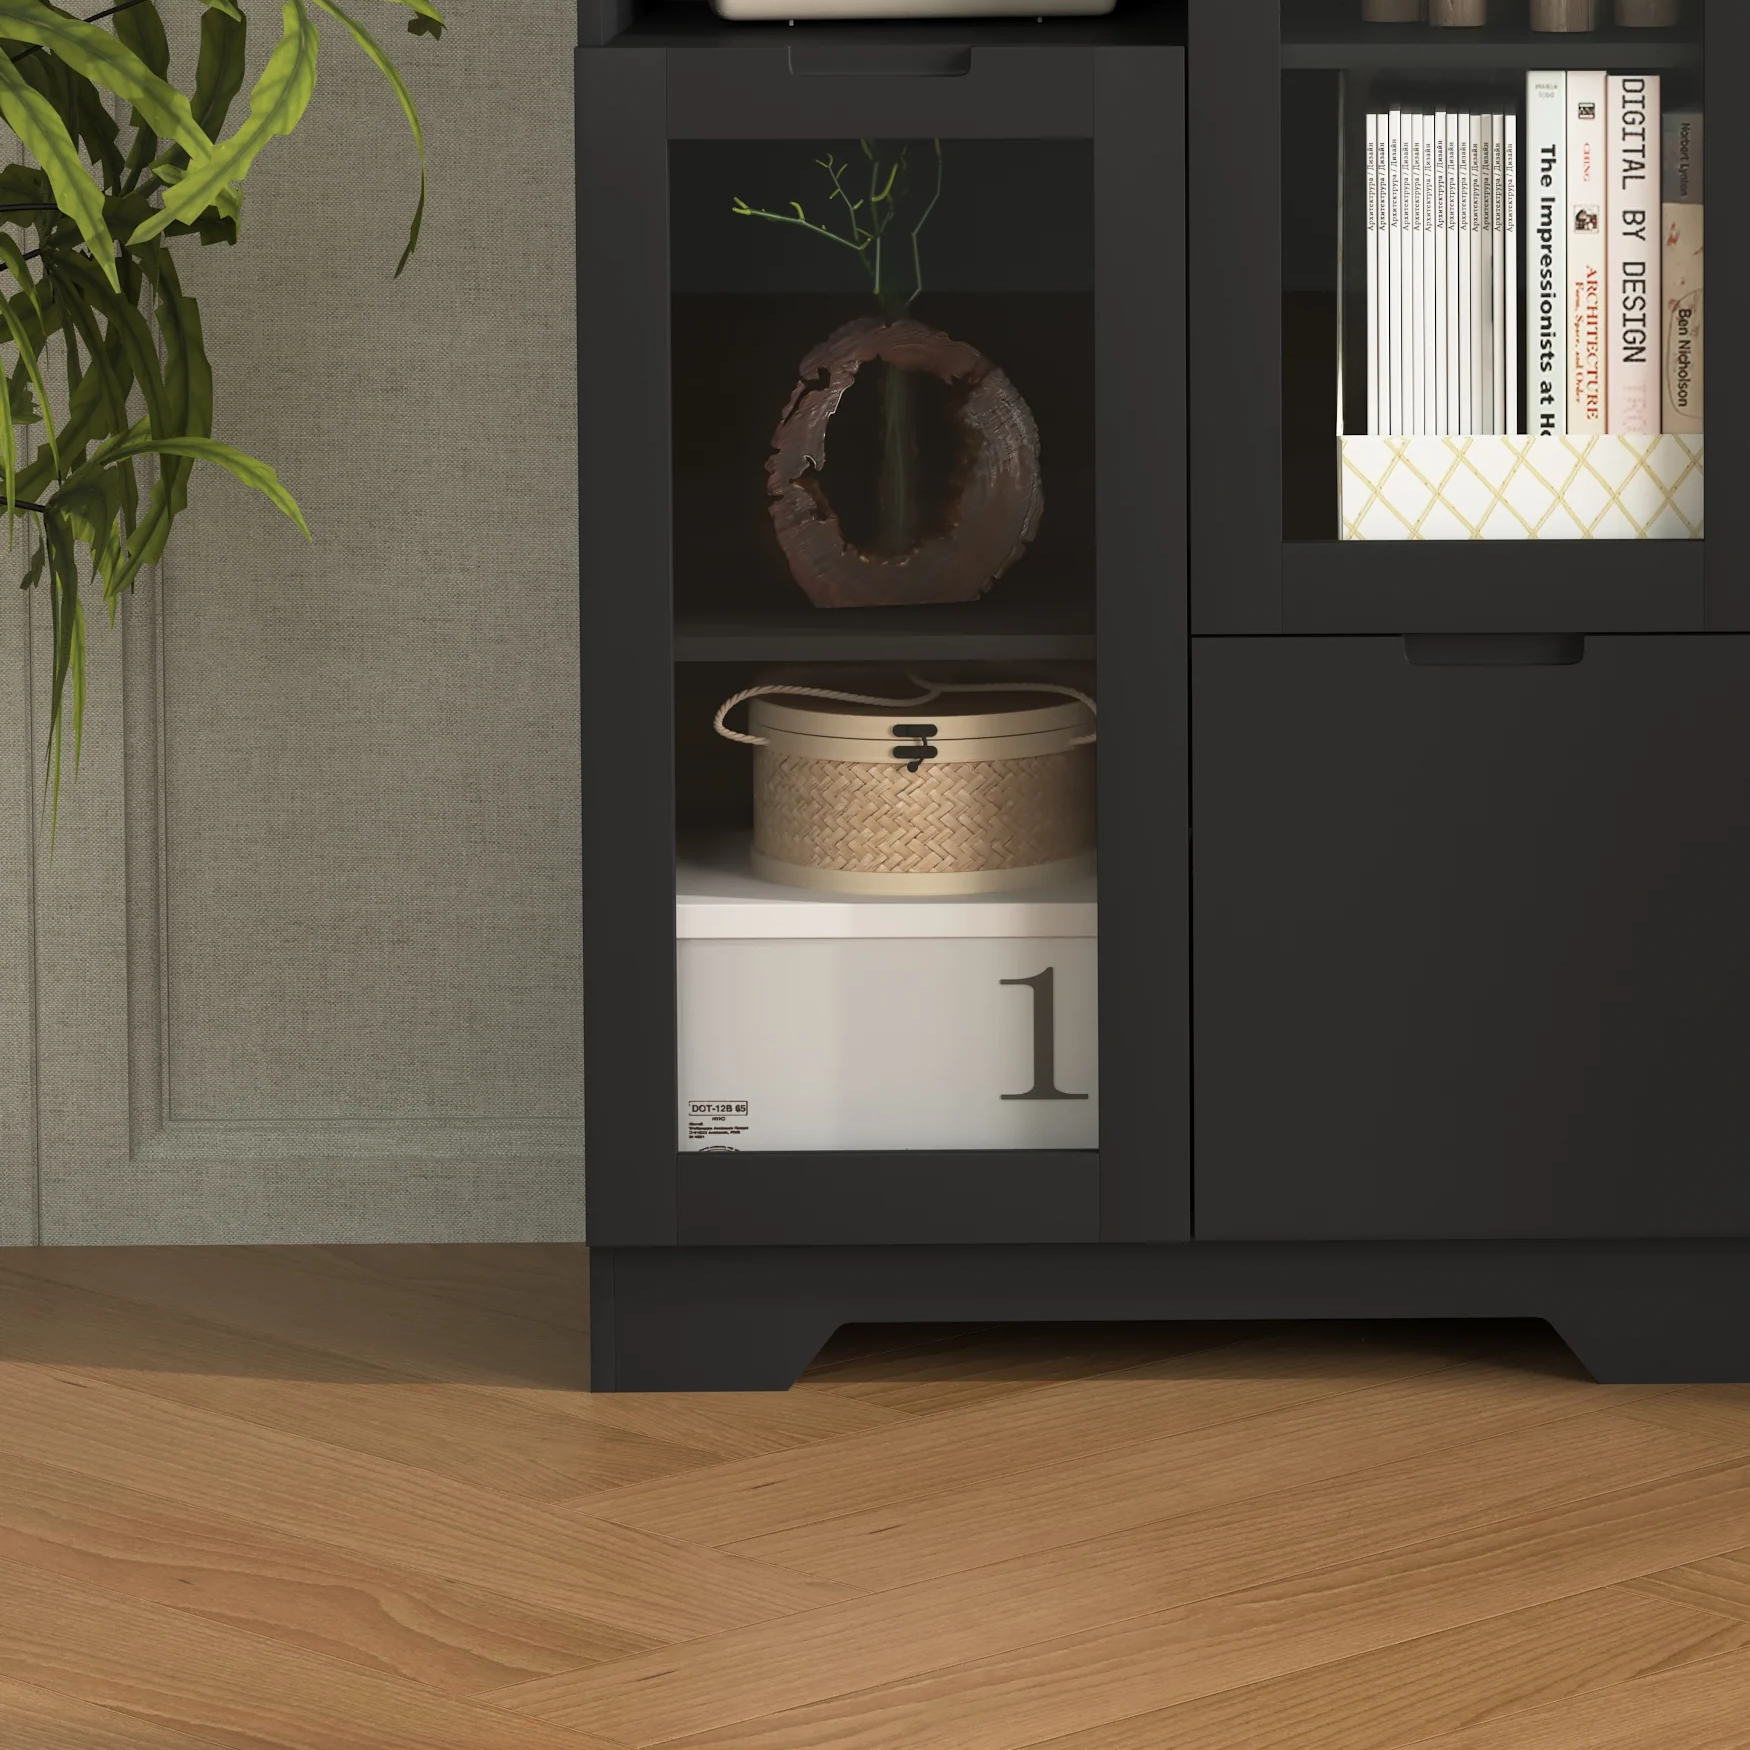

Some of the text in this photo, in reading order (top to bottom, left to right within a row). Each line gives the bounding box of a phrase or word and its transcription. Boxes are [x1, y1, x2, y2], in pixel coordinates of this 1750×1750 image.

[1622, 78, 1646, 190] DIGITAL
[1536, 144, 1557, 405] The Impressionists at
[1622, 209, 1646, 241] BY
[1586, 265, 1598, 420] ARCHITECTURE
[1622, 261, 1646, 363] DESIGN
[1677, 308, 1692, 407] Ben Nicholson
[999, 966, 1090, 1100] 1
[691, 1104, 733, 1112] DOT-12B
